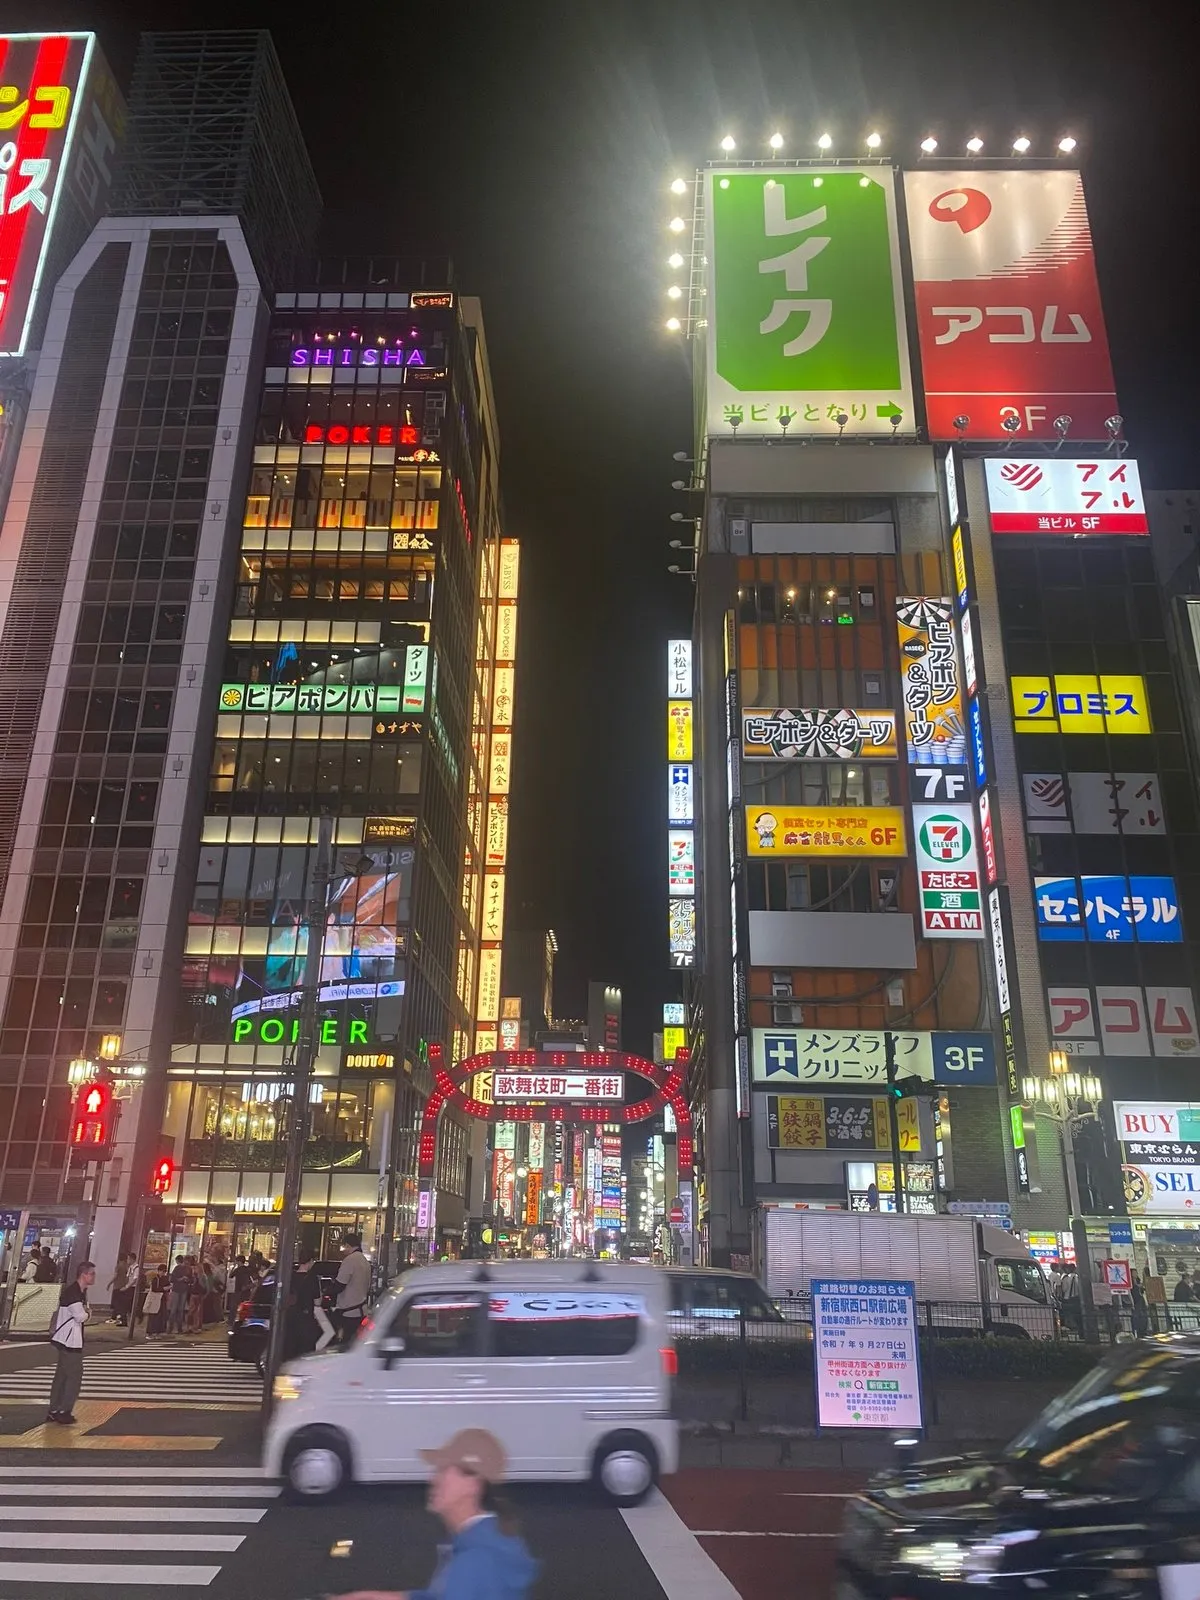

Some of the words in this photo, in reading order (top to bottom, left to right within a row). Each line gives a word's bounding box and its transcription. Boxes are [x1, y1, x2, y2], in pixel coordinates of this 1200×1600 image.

[758, 183, 833, 357] レイク
[931, 305, 1092, 345] アコム
[292, 349, 424, 365] SHISHA
[723, 403, 867, 422] 当ビルとなり
[306, 426, 417, 443] POKER
[1038, 517, 1076, 529] 当ビル
[1081, 517, 1100, 529] 5F
[503, 564, 511, 590] ABYSS
[502, 608, 511, 635] CASINO
[409, 648, 425, 682] ダーツ
[674, 643, 687, 694] 小松ビル
[929, 622, 957, 704] ビアポン
[247, 686, 398, 710] ビアポンバー
[1023, 690, 1140, 715] プロミス
[745, 719, 893, 746] ビアポン&ダーツ
[915, 768, 965, 799] 7F
[870, 827, 897, 846] 6F
[928, 873, 972, 888] たばこ
[940, 893, 962, 908] 酒
[1038, 894, 1177, 924] セントラル
[929, 913, 978, 928] ATM
[1105, 929, 1120, 940] 4F
[673, 953, 693, 966] 7F
[1050, 998, 1193, 1034] アコム
[1065, 1042, 1085, 1054] 3F
[346, 1054, 394, 1067] DOUTOR
[944, 1046, 984, 1071] 3F
[497, 1077, 620, 1096] 歌舞伎町一番街
[783, 1111, 822, 1129] 鉄鍋
[1123, 1114, 1174, 1133] BUY
[783, 1128, 822, 1146] 餃子
[837, 1125, 863, 1140] 酒場
[820, 1284, 907, 1295] 道路切替のお知らせ
[820, 1297, 908, 1313] 新宿駅西口駅前広場
[821, 1315, 909, 1326] 自動車の通行ルートが変わります
[823, 1329, 846, 1337] 実施日時
[822, 1340, 837, 1348] 令和
[848, 1340, 856, 1349] 年
[827, 1360, 908, 1370] 甲州街道方面へ通り抜けが
[828, 1369, 881, 1377] できなくなります
